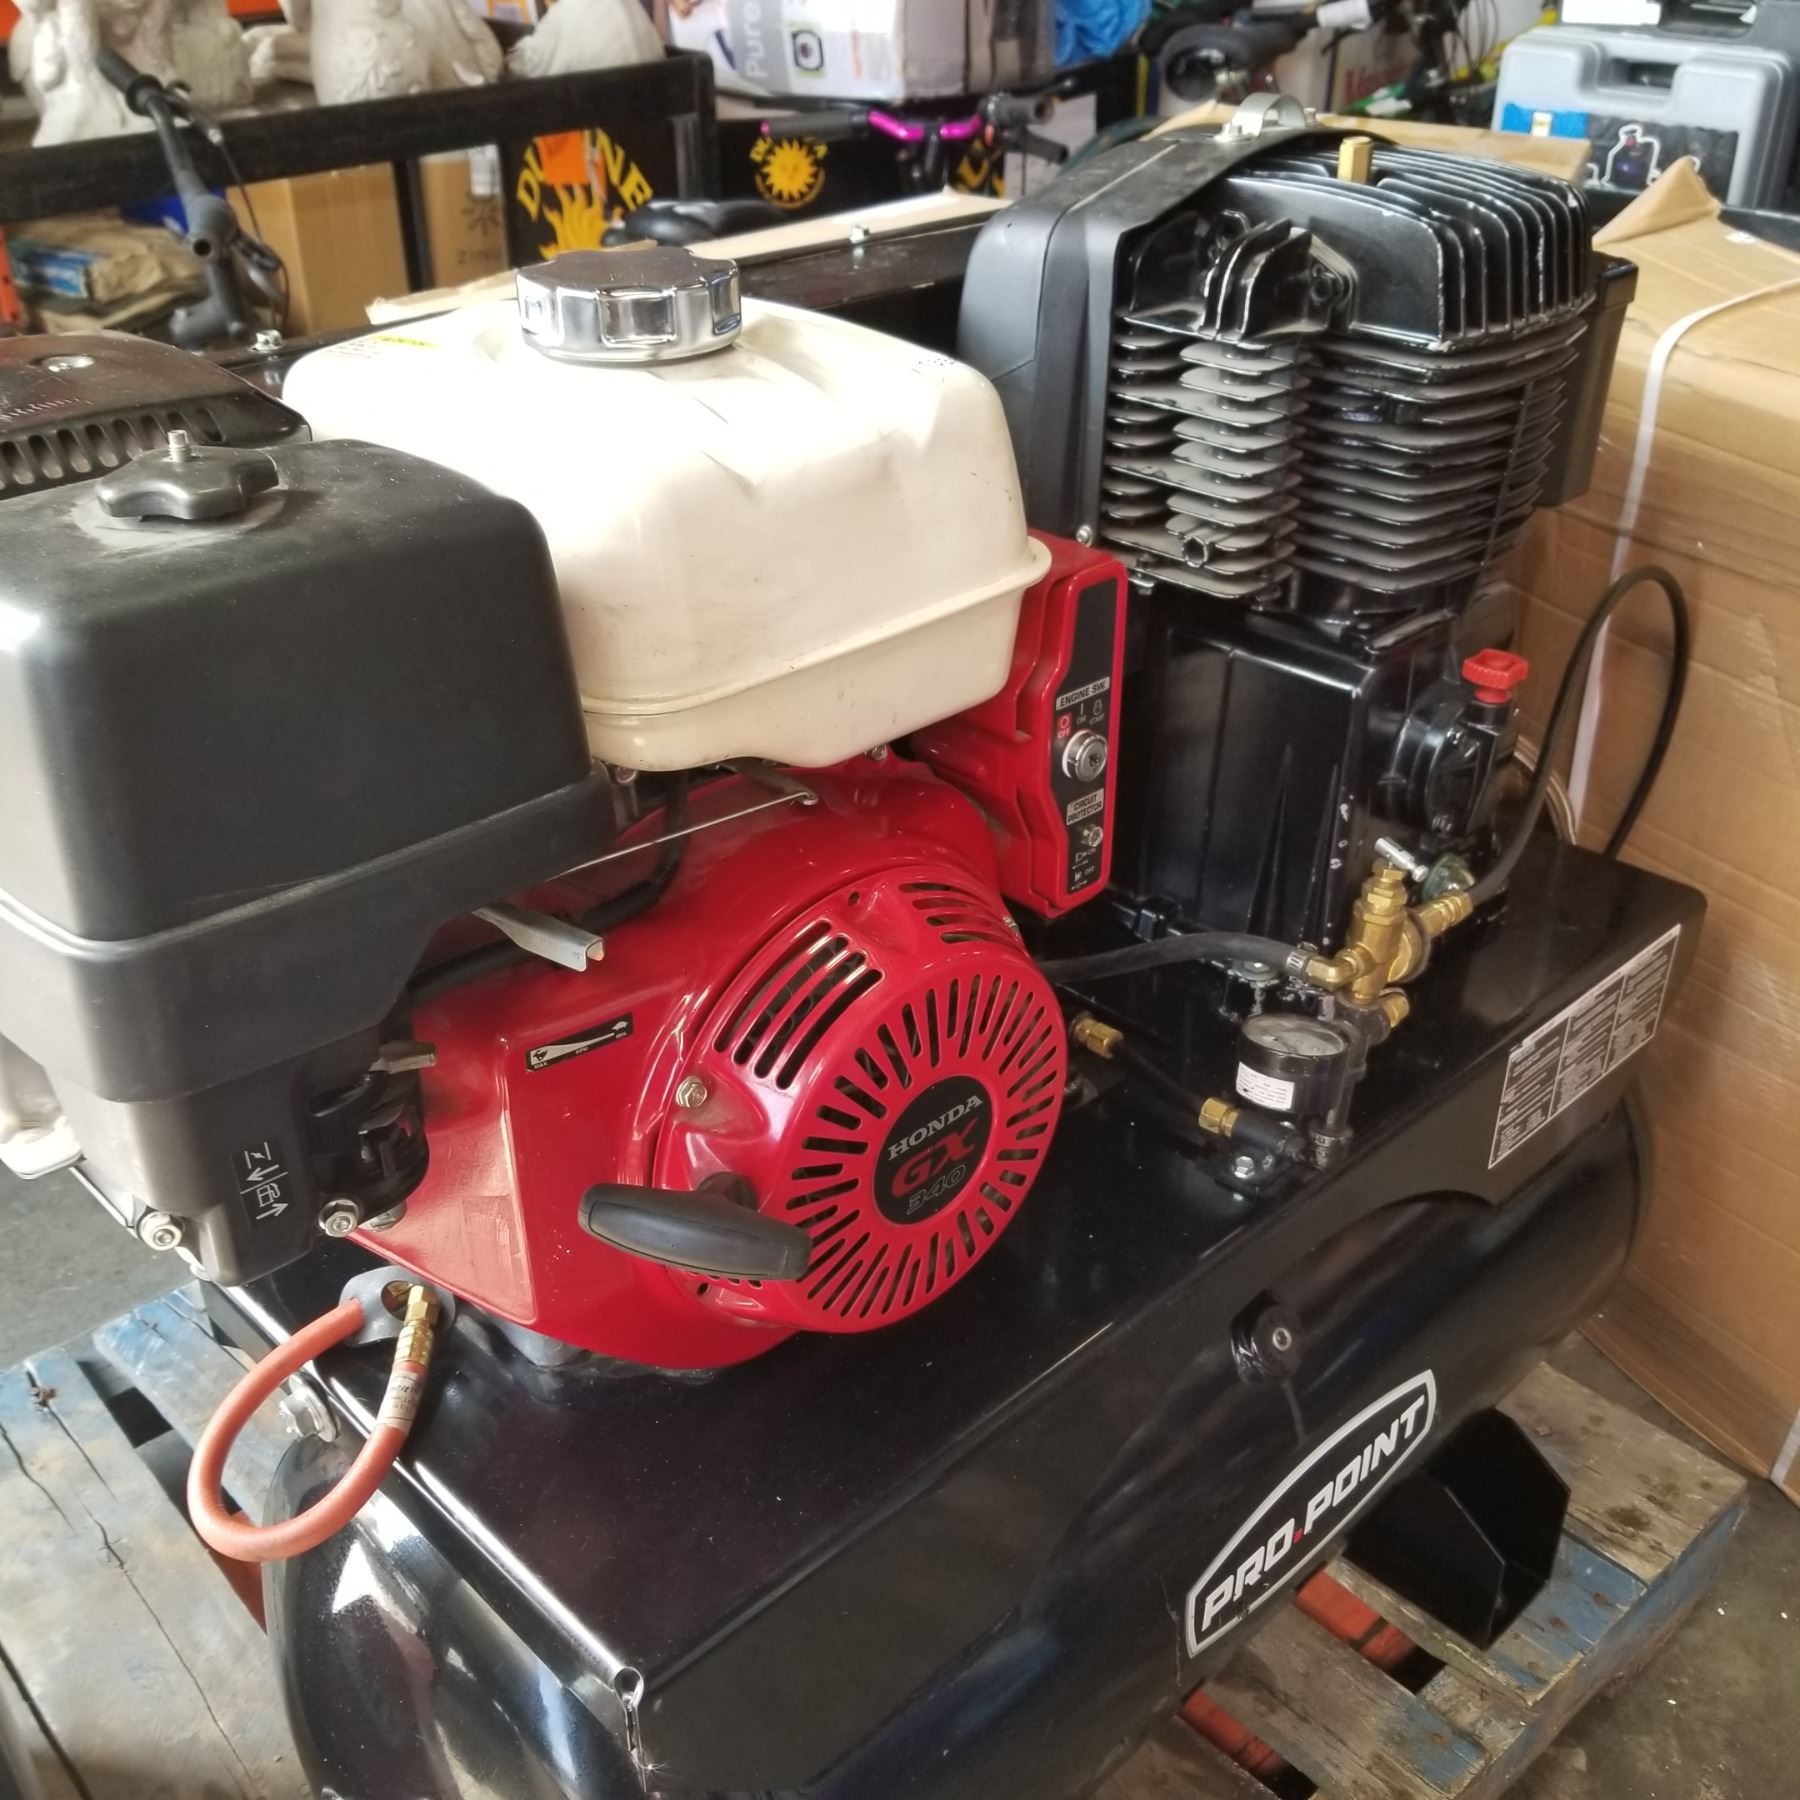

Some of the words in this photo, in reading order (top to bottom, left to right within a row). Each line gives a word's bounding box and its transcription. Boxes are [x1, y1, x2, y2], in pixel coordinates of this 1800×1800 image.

[1060, 687, 1091, 707] ENGINE
[1067, 801, 1102, 823] PROTECTOR
[1073, 793, 1098, 811] CIRCUIT
[887, 1095, 983, 1161] HONDA
[891, 1117, 979, 1199] GX
[906, 1164, 967, 1216] 340
